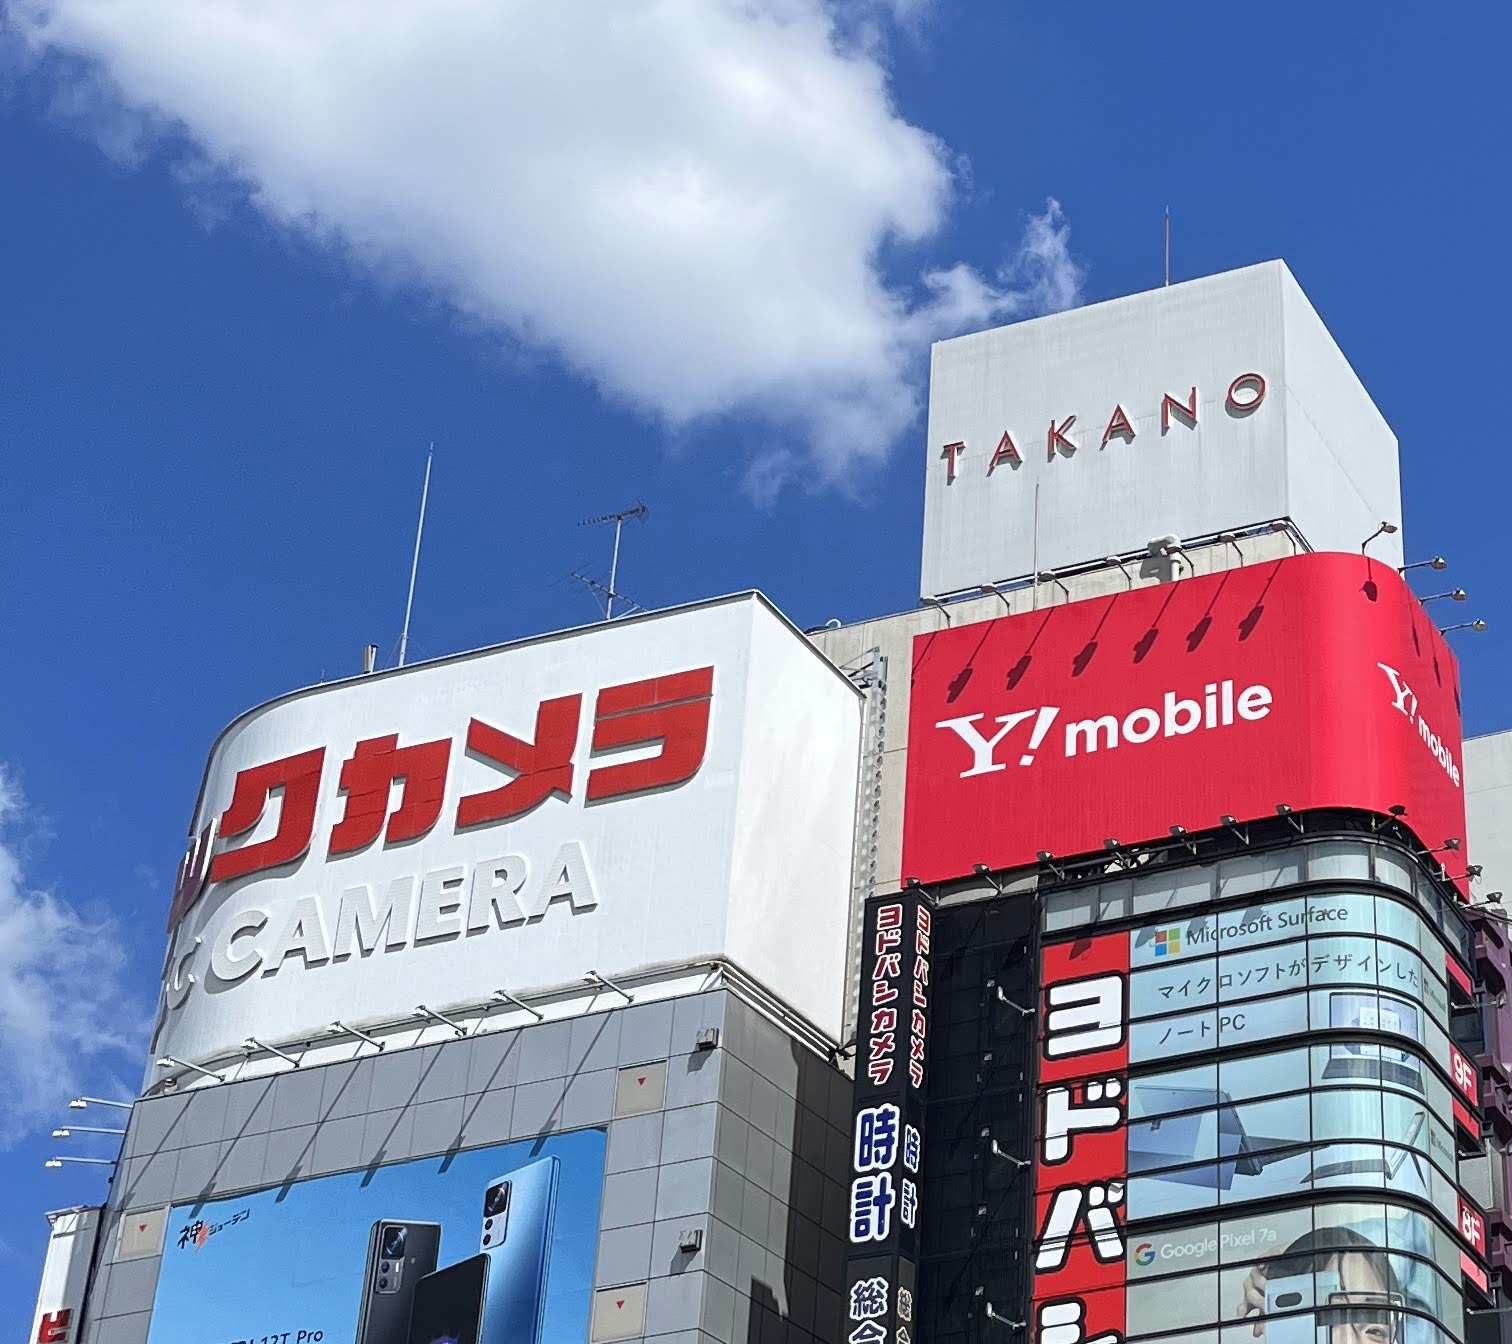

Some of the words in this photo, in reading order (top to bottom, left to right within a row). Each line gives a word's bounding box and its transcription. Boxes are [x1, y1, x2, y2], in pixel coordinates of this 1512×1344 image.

[941, 373, 1267, 480] TAKANO
[211, 842, 598, 982] CAMERA
[1187, 914, 1272, 947] Microsoft
[1278, 905, 1348, 929] Surface
[869, 903, 901, 1086] ヨドバシカメラ
[910, 904, 931, 1089] ヨドバシカメラ
[1158, 953, 1420, 1001] マイクロソフトがデザインした
[1453, 1052, 1472, 1092] 9F
[850, 1103, 900, 1243] 時計
[900, 1123, 920, 1229] 時計
[1161, 1236, 1217, 1263] Google
[1220, 1231, 1253, 1254] Pixel
[1258, 1228, 1278, 1245] 7a
[1462, 1206, 1481, 1246] 8F
[296, 1329, 324, 1344] Pro
